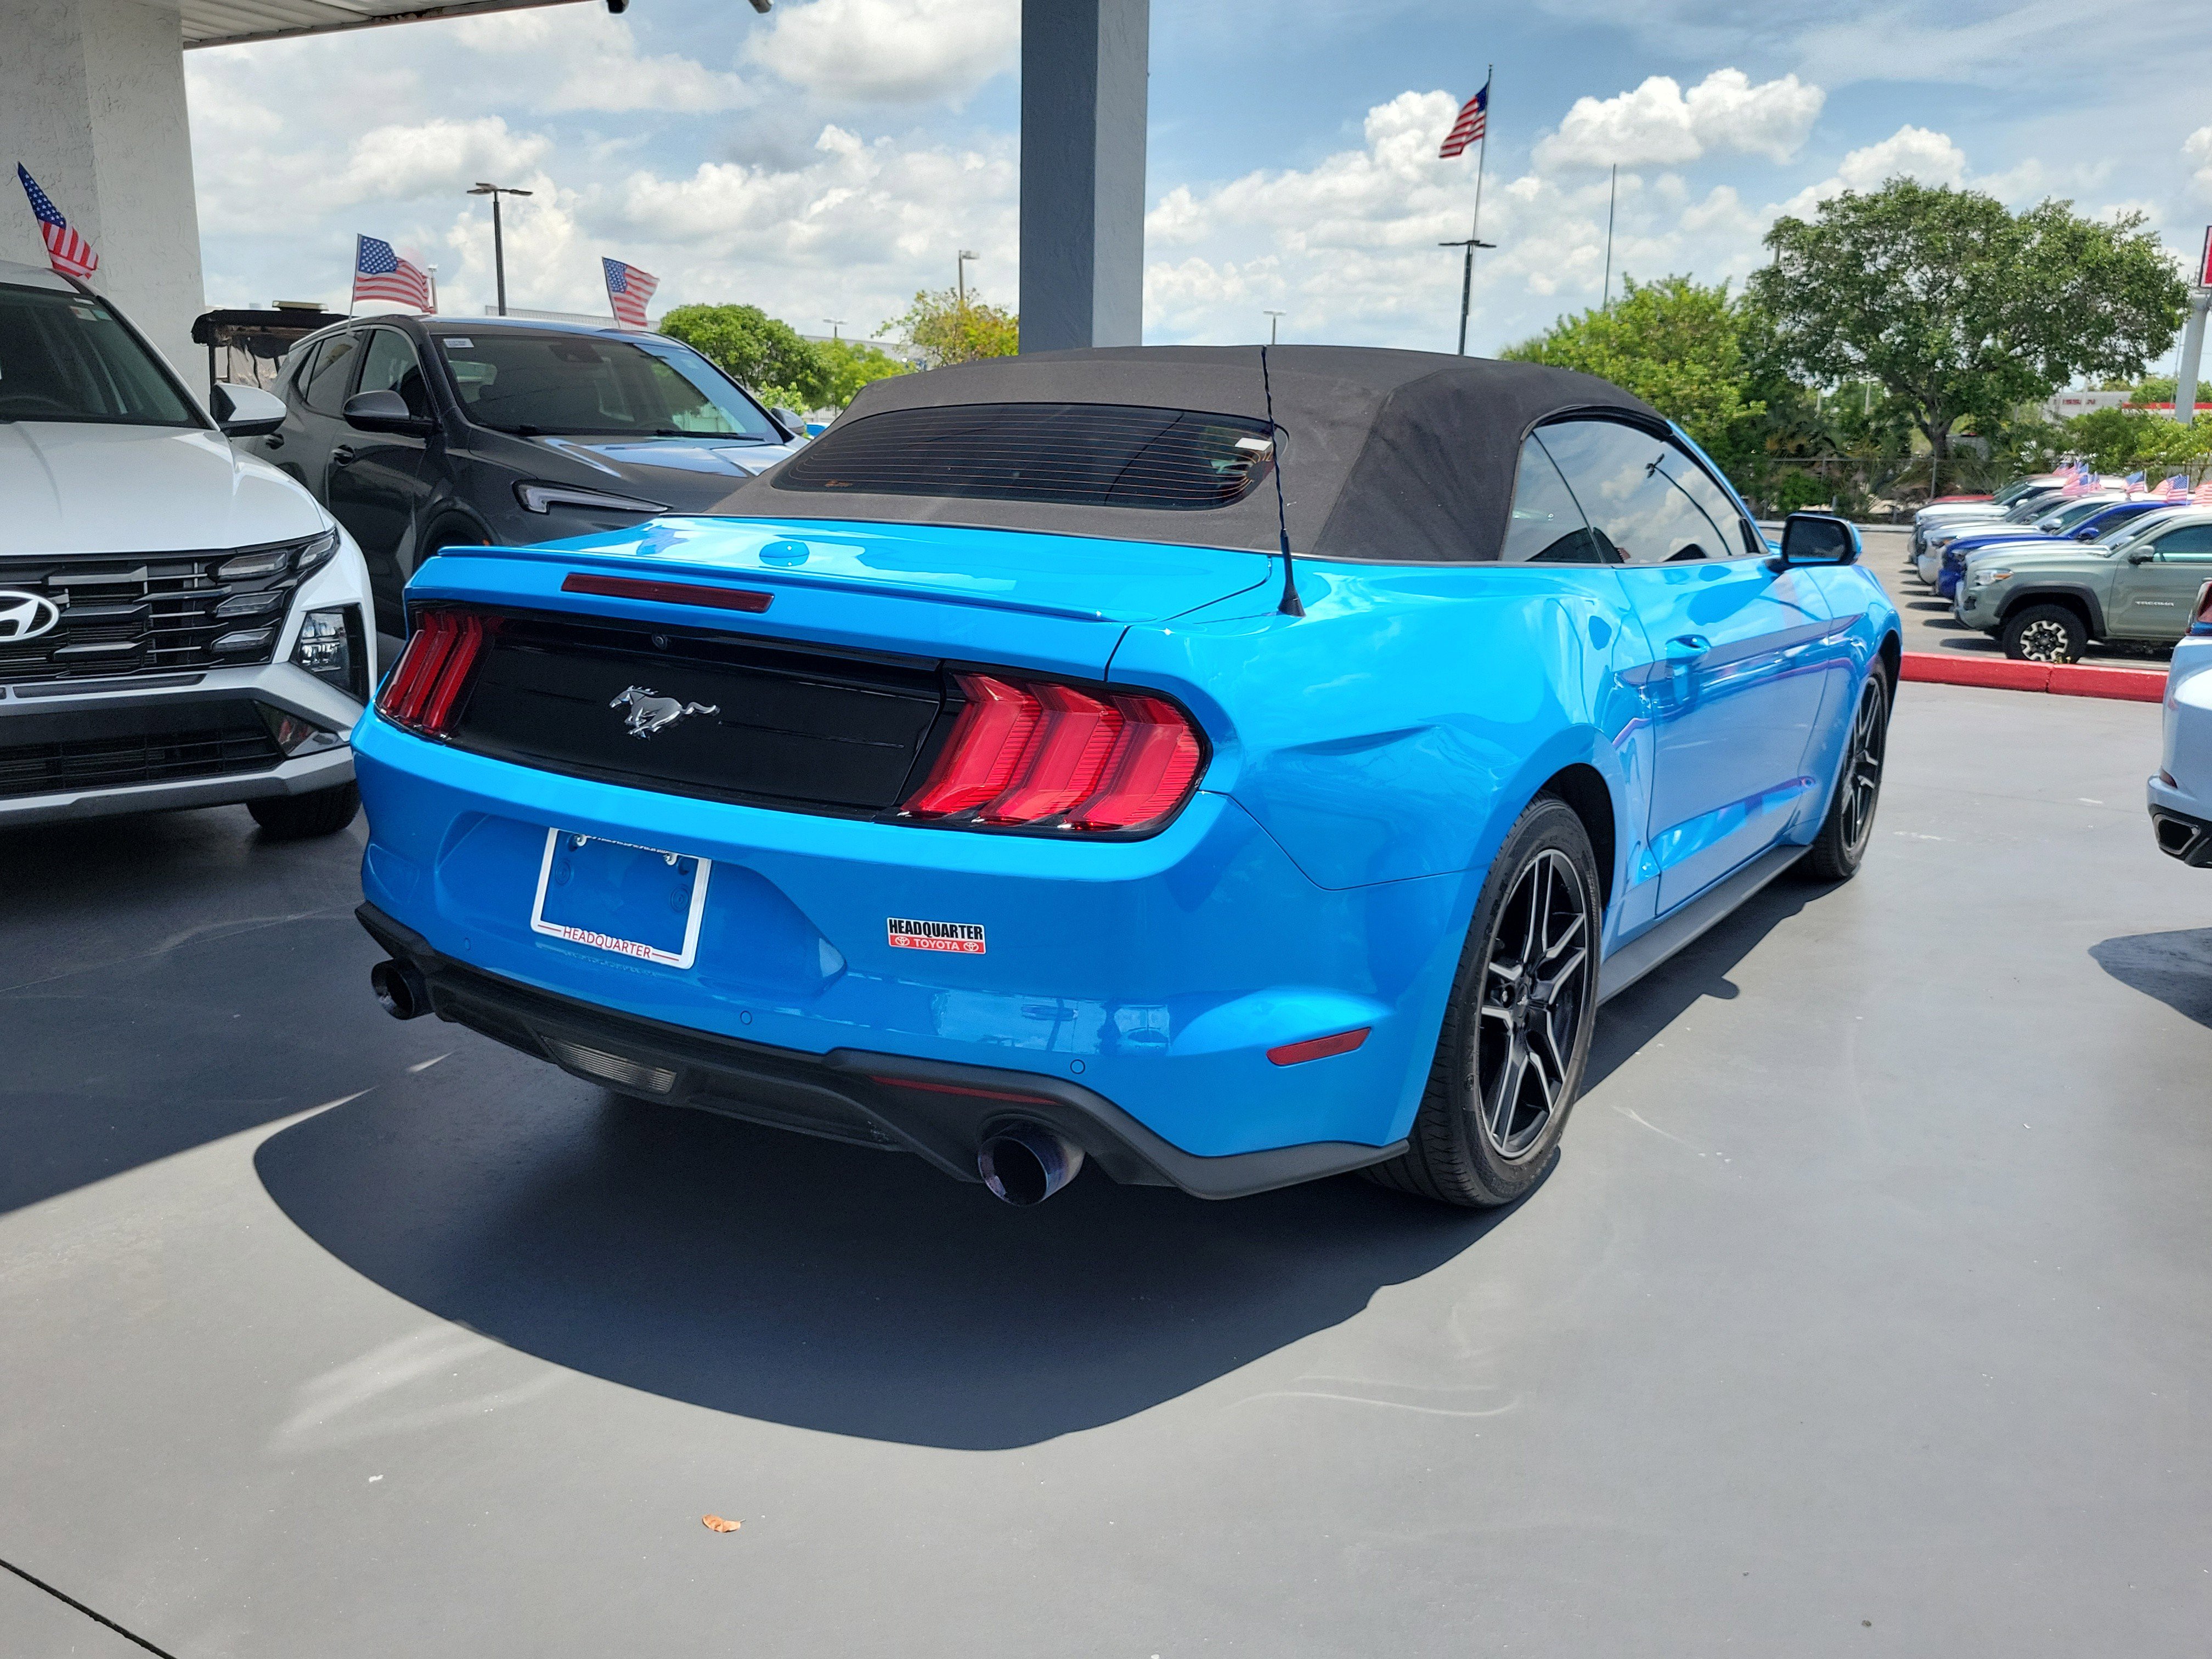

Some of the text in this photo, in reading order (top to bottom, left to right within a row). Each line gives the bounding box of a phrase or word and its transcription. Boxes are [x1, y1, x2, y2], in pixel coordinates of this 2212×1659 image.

[889, 919, 983, 940] HEADQUARTER
[563, 926, 651, 958] HEADQUARTER
[913, 938, 960, 951] TOYOTA
